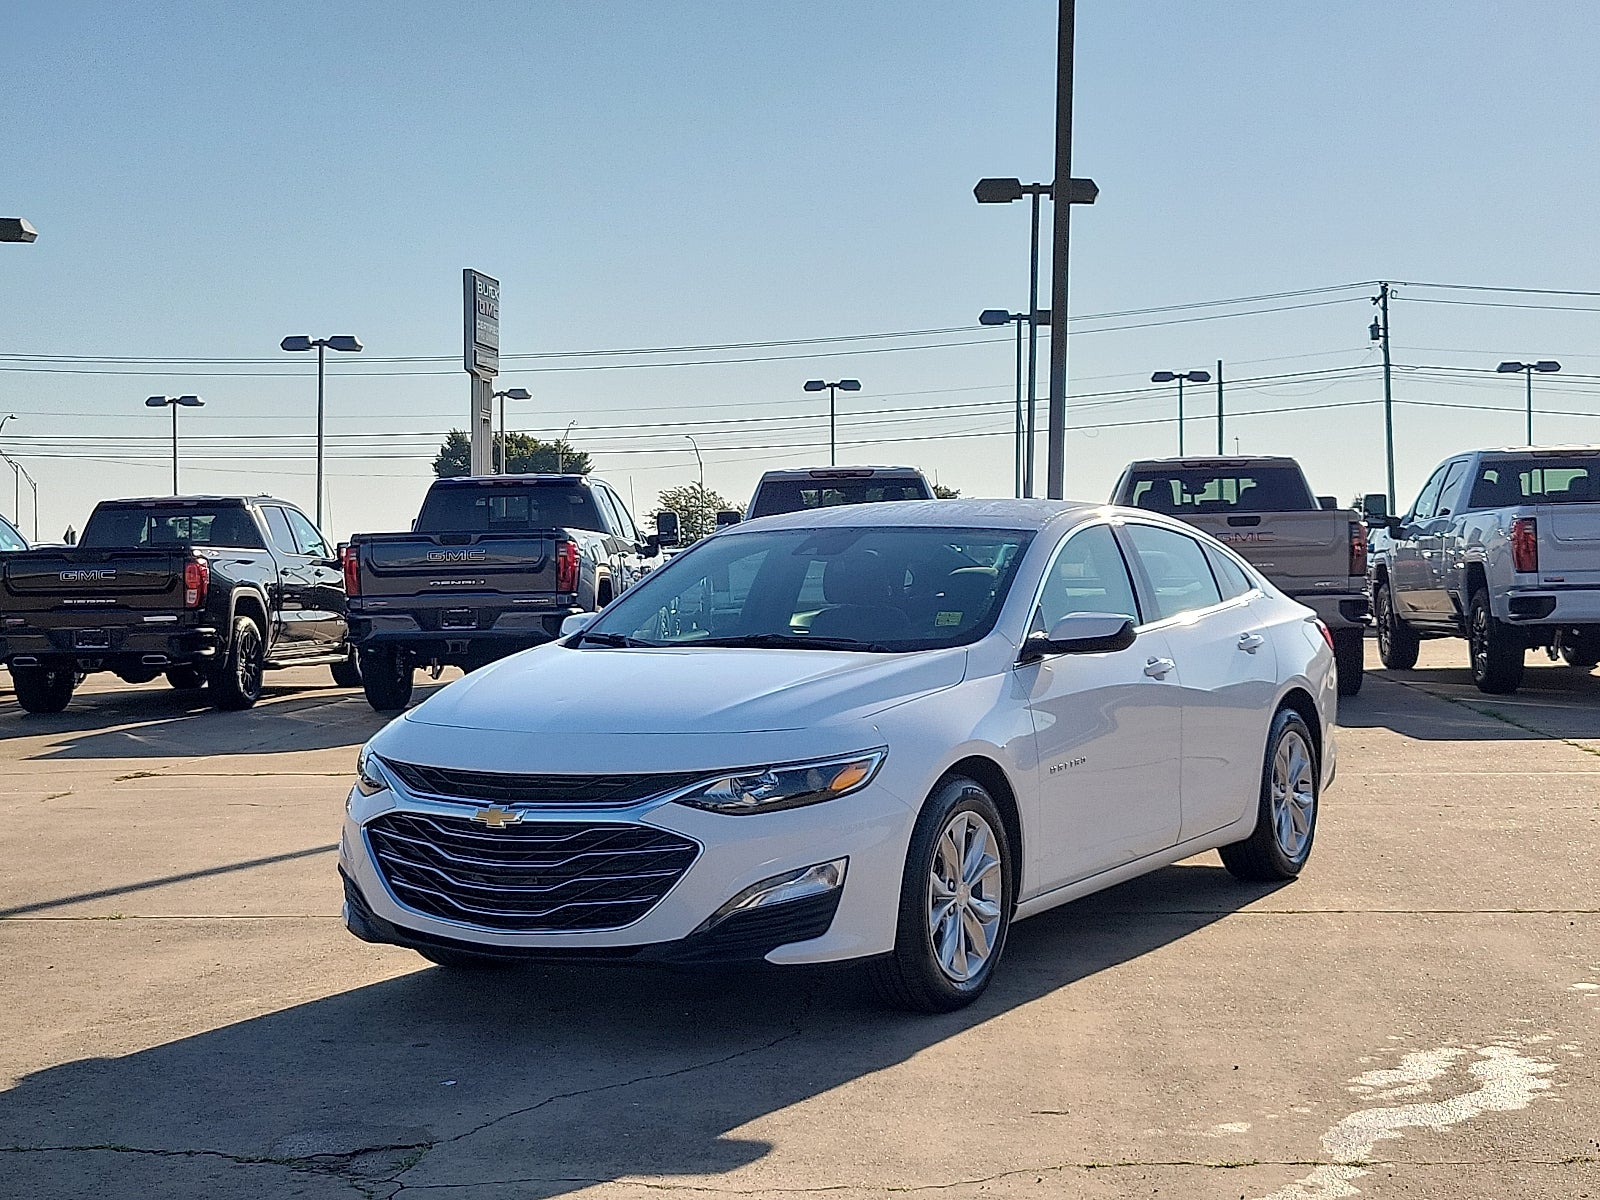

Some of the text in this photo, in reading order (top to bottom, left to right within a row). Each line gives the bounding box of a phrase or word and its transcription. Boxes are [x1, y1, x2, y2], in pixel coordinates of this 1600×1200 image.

[477, 281, 499, 301] BUICK
[1215, 531, 1276, 544] GMC
[427, 549, 486, 562] GMC
[60, 569, 117, 582] GMC
